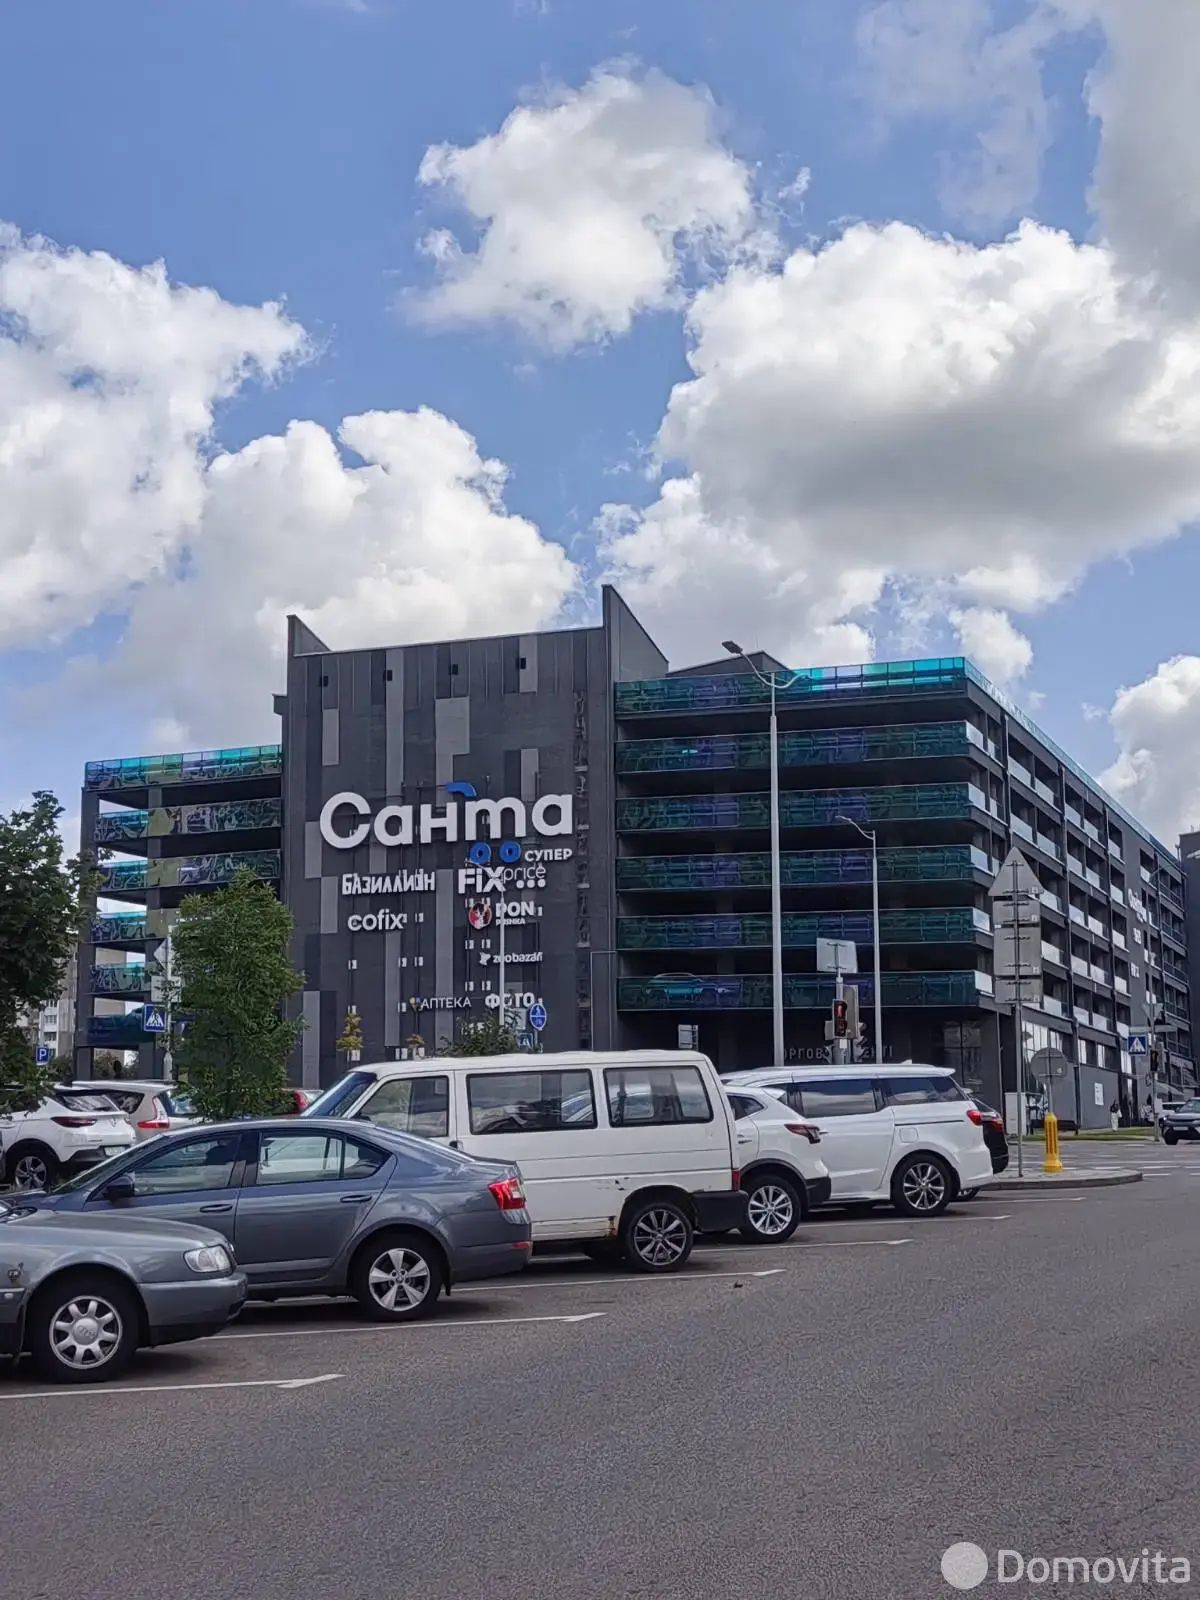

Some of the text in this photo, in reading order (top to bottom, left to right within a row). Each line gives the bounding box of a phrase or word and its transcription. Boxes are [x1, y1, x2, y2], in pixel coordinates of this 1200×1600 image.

[320, 792, 573, 849] Санта
[524, 848, 573, 862] СУПЕР
[503, 865, 546, 884] price
[347, 908, 404, 931] cofix
[422, 997, 472, 1009] АПТЕКА
